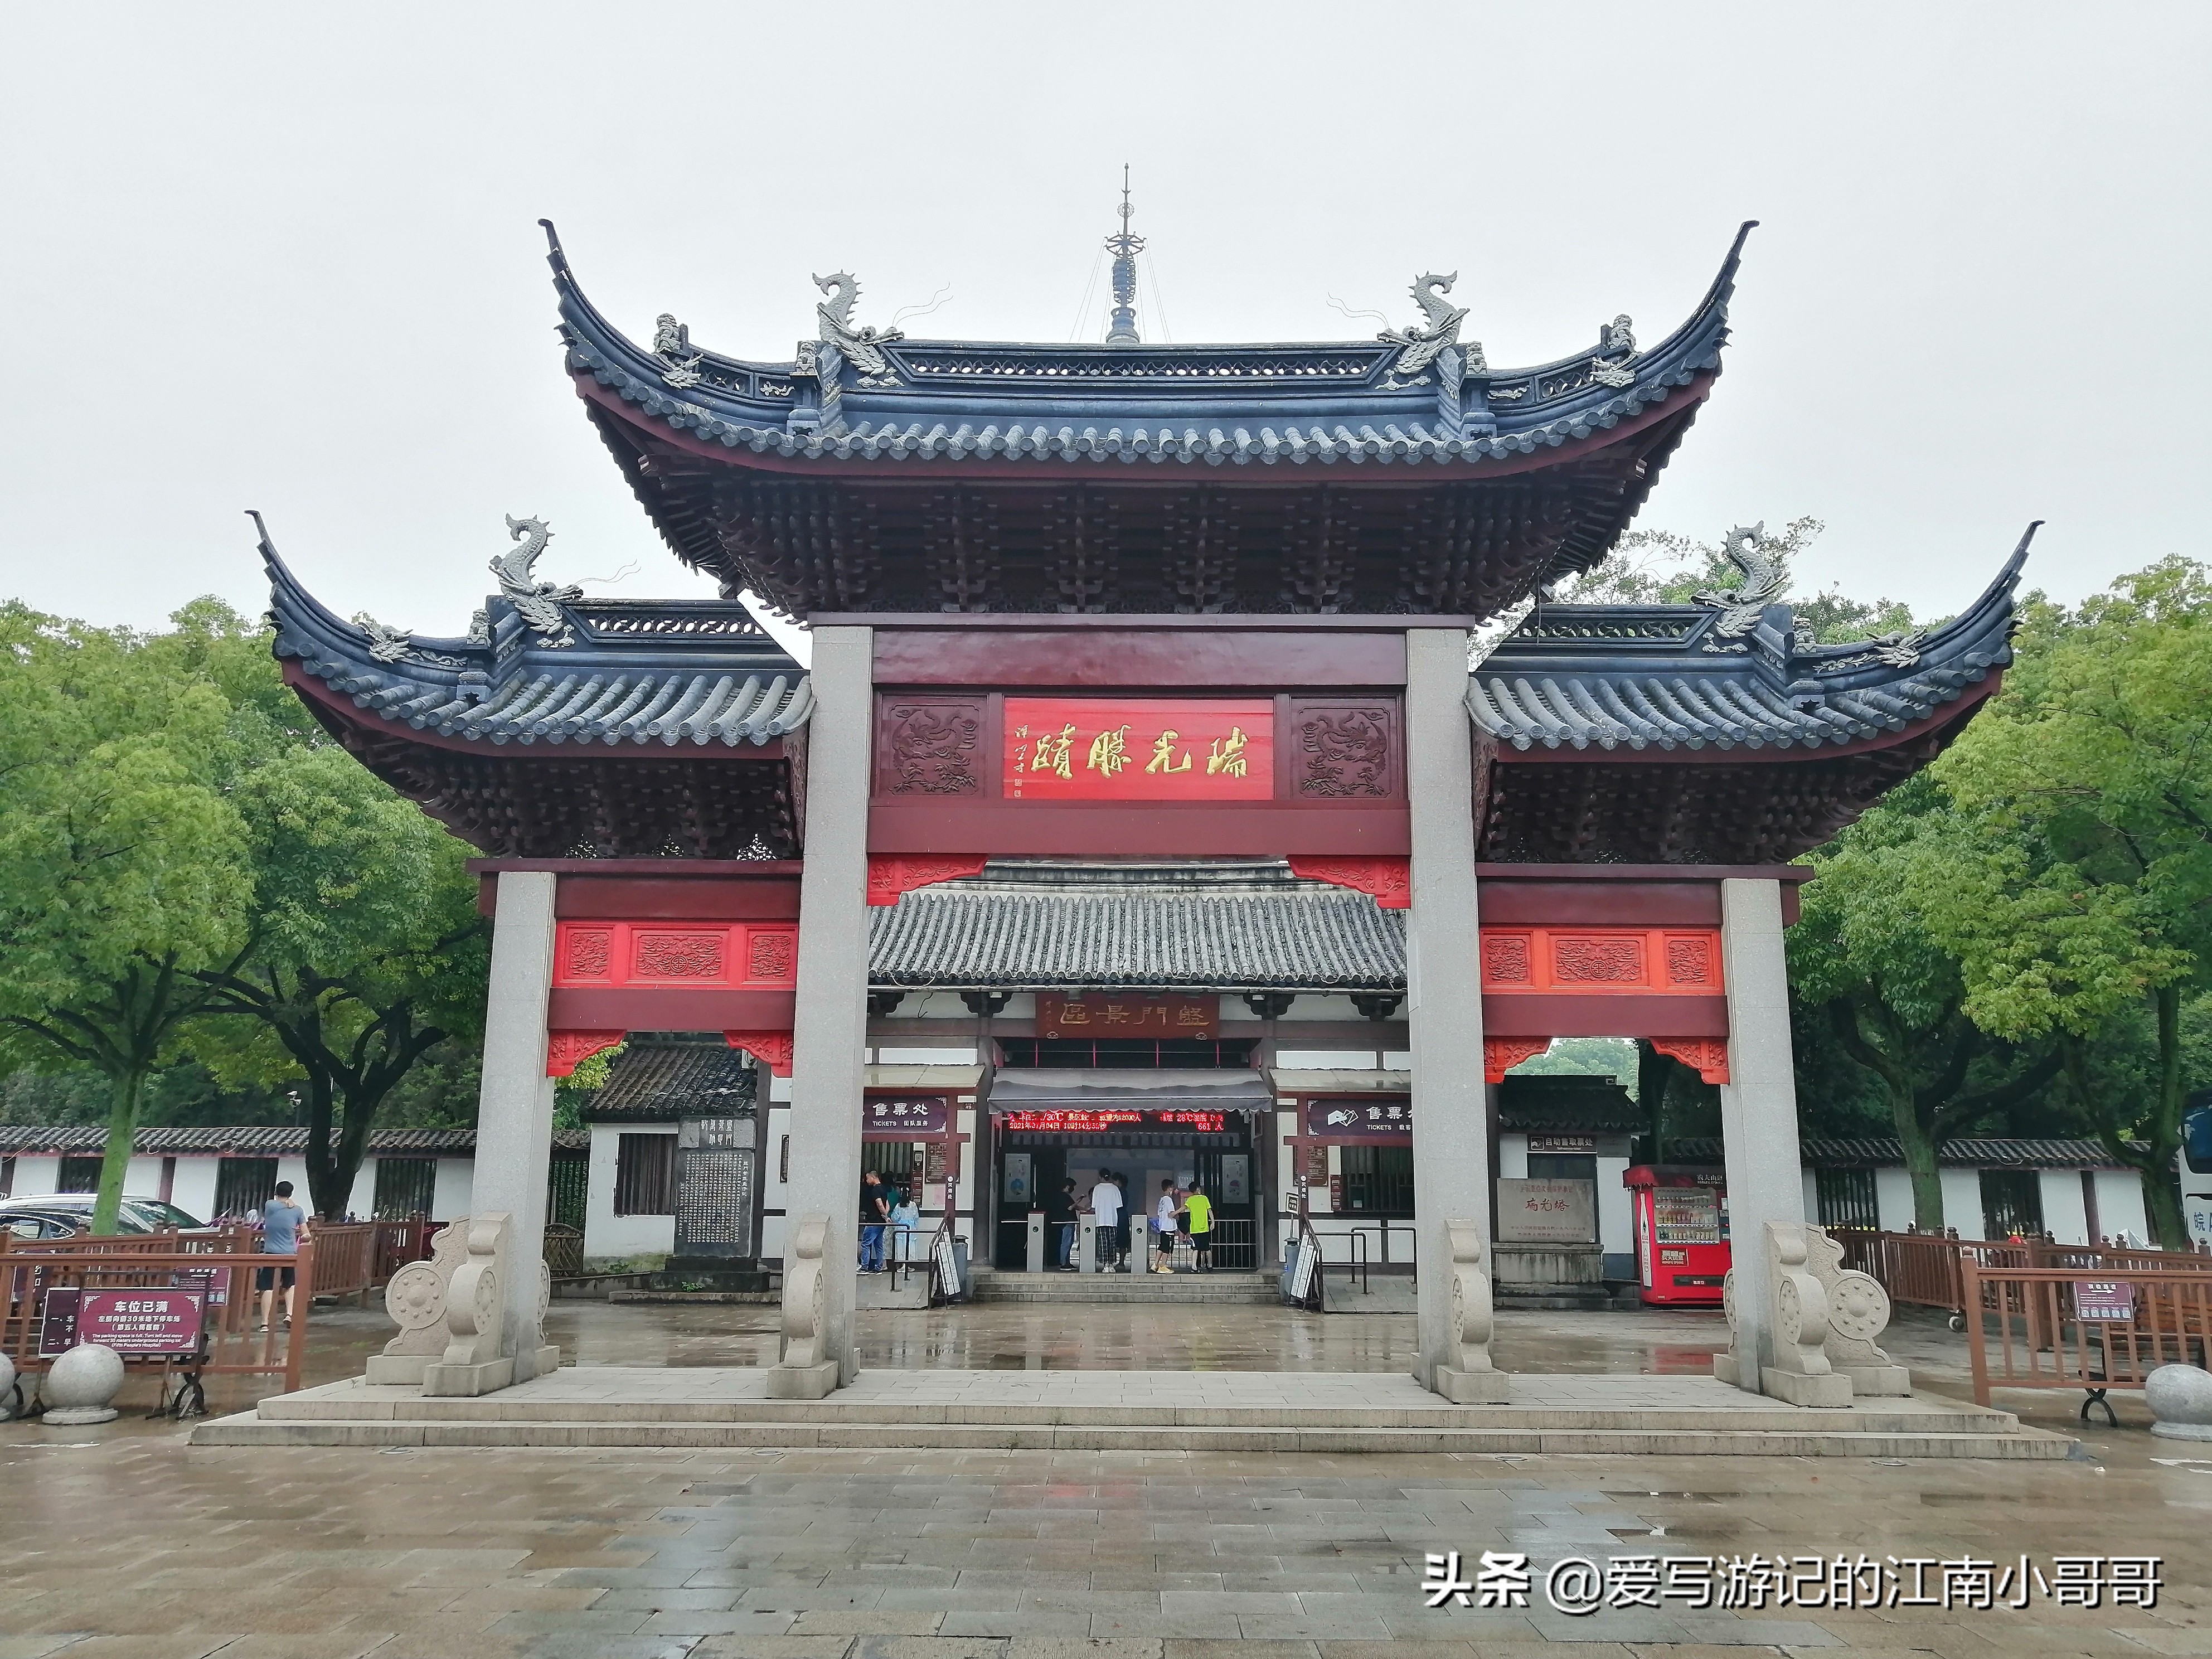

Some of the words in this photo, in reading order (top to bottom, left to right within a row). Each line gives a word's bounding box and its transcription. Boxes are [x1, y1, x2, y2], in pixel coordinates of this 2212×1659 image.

[872, 1103, 929, 1116] 售票处
[1366, 1107, 1413, 1120] 售票
[1545, 1138, 1593, 1146] 自助售取票处
[1525, 1197, 1571, 1211] 瑞光塔
[114, 1301, 169, 1313] 车位已满
